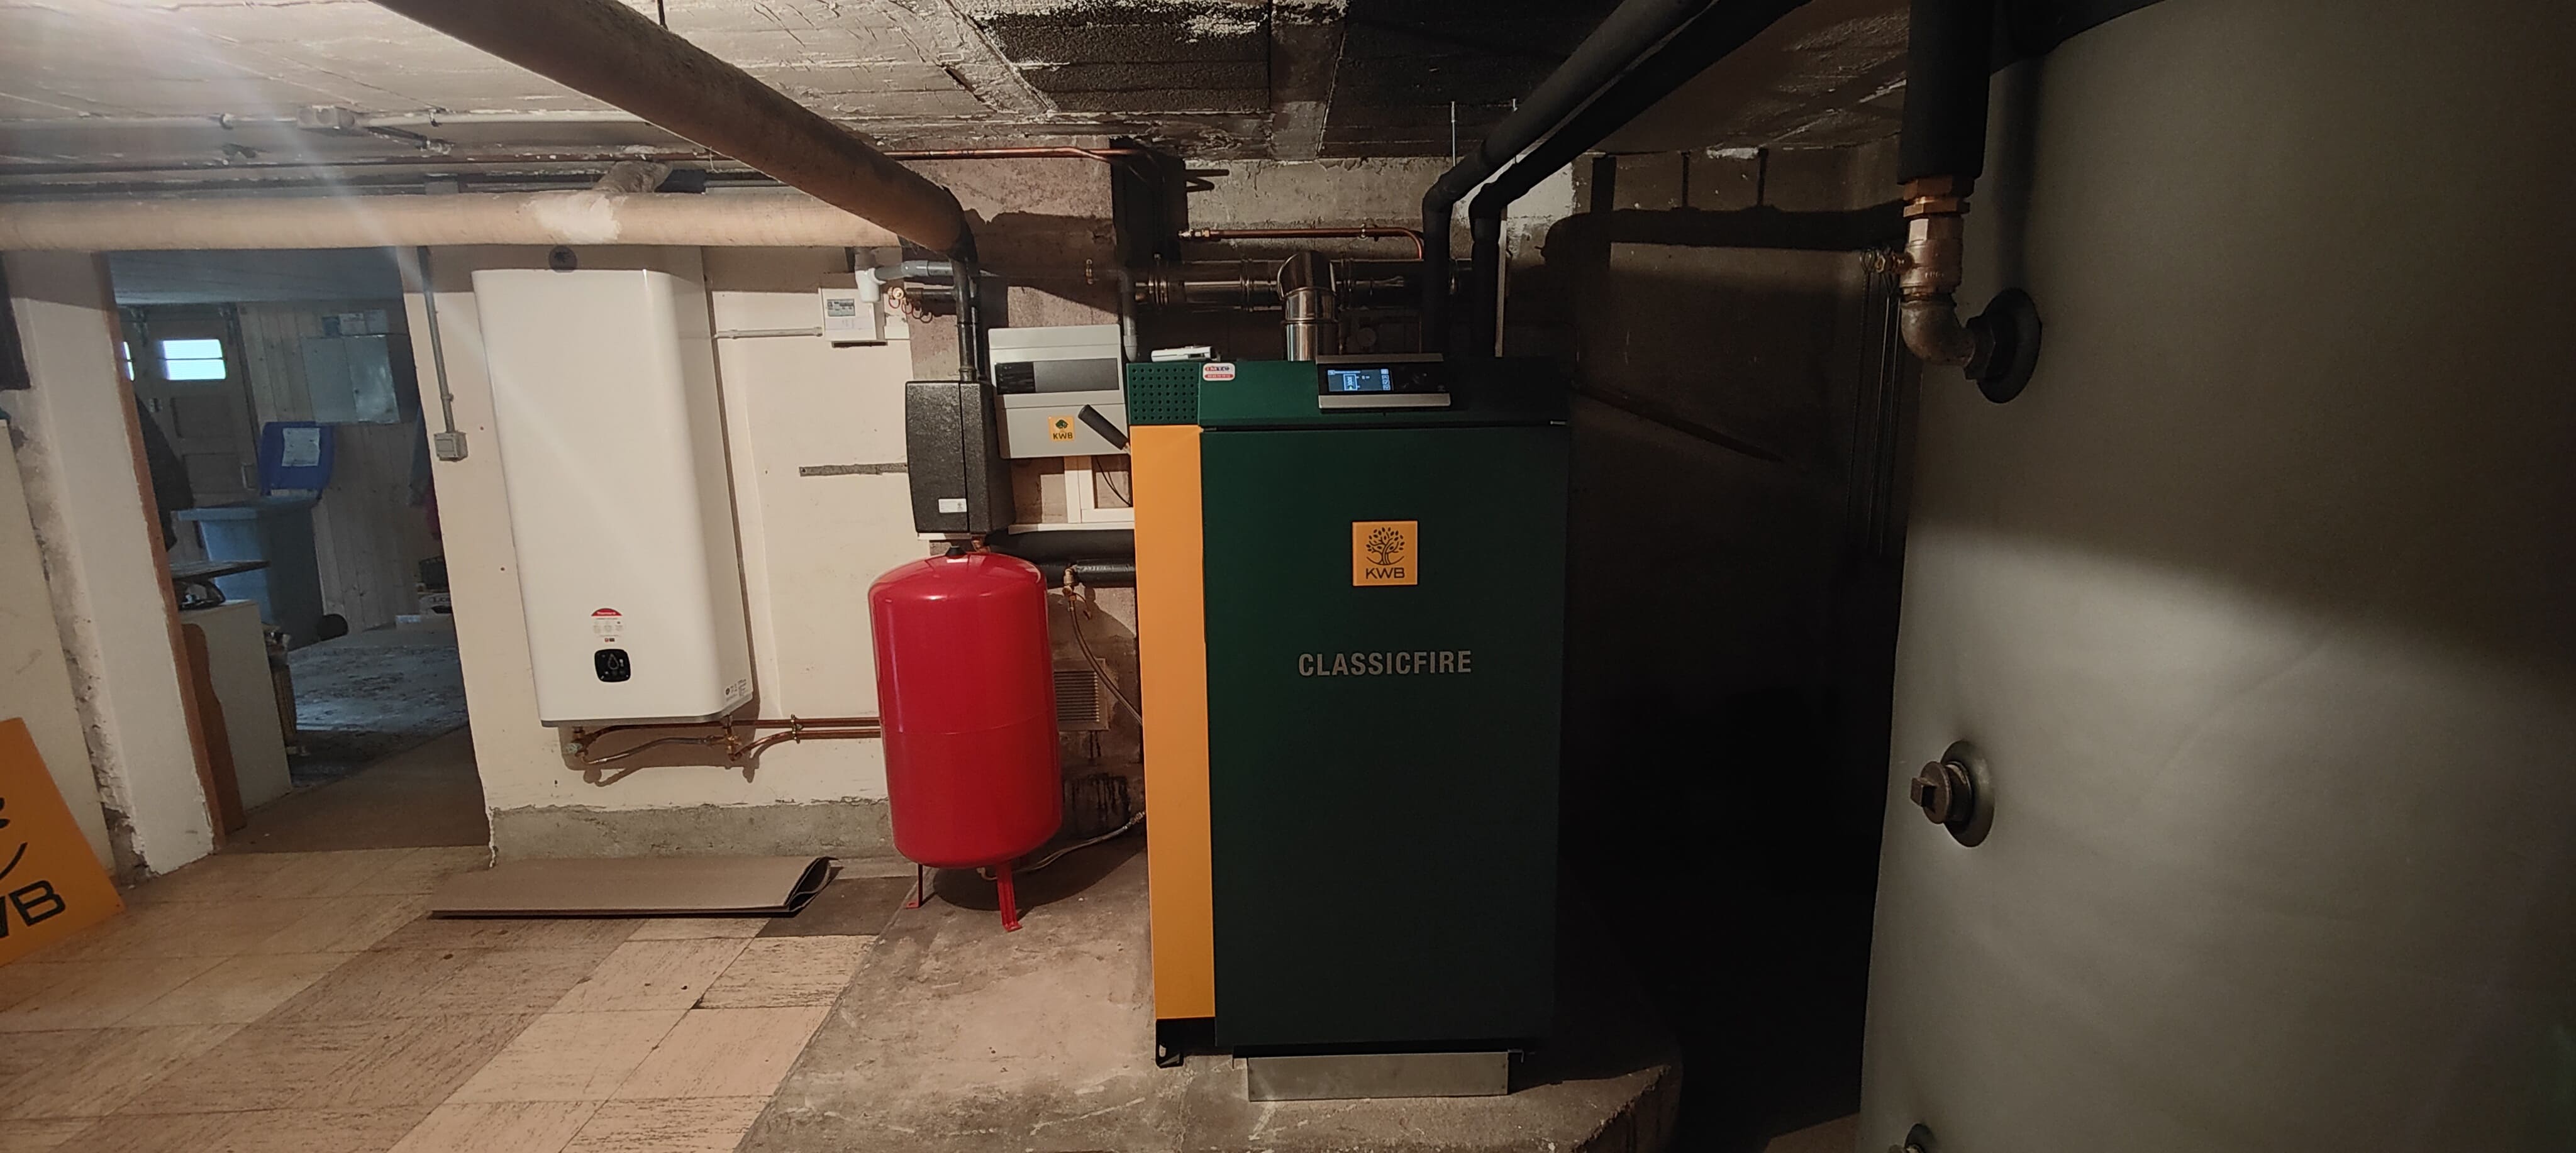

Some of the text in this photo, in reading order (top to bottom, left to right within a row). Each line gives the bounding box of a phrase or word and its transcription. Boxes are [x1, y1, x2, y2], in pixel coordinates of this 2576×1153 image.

[1365, 567, 1405, 579] KWB
[1299, 651, 1472, 676] CLASSICFIRE
[0, 880, 66, 938] B
